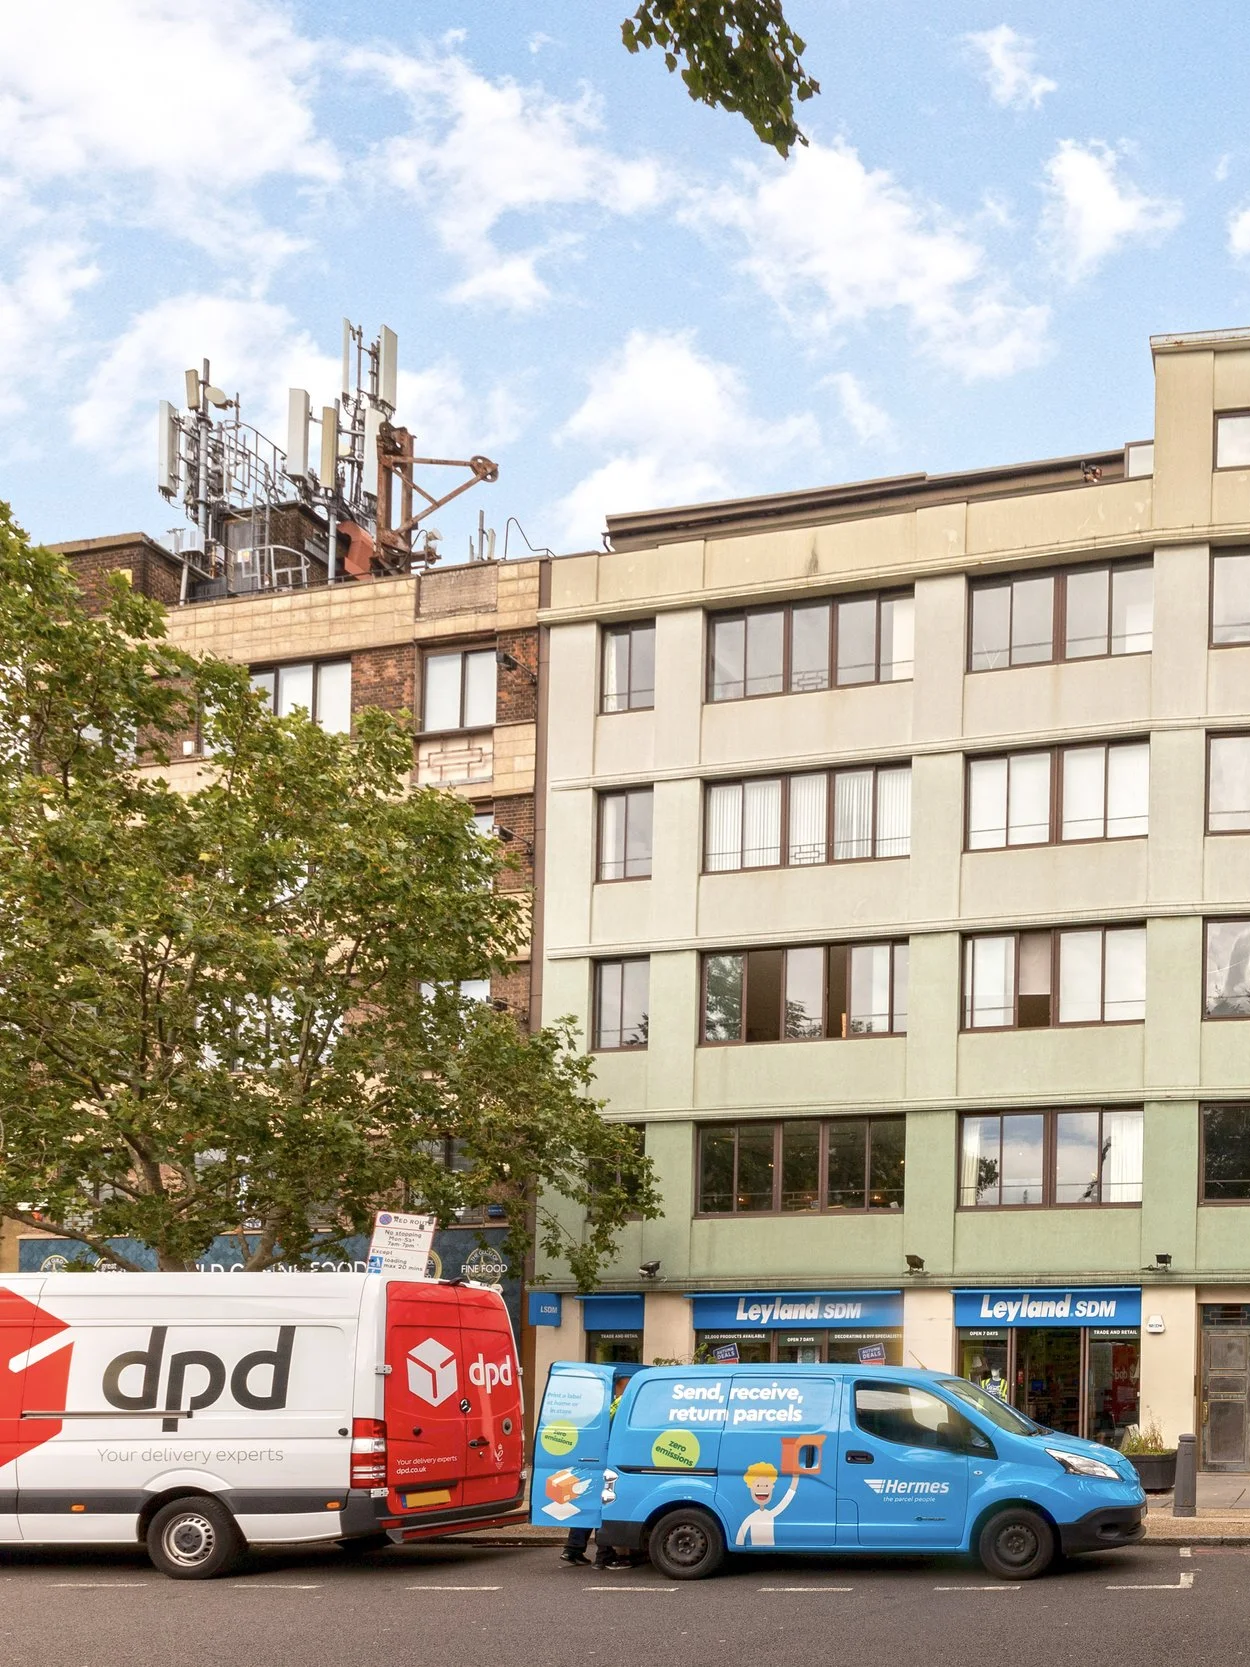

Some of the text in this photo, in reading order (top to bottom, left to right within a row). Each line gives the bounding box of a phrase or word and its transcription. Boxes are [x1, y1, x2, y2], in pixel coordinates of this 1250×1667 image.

[395, 1230, 422, 1238] stopping
[384, 1257, 407, 1265] loading
[461, 1264, 508, 1274] FINE FOOD
[540, 1305, 558, 1313] LSDM
[736, 1297, 862, 1324] Leyland SDM
[980, 1294, 1117, 1322] Leyland SDM
[717, 1350, 735, 1360] DEALS
[862, 1350, 881, 1359] DEALS
[102, 1325, 296, 1432] dpd
[468, 1353, 513, 1394] dpd
[671, 1382, 804, 1404] Send, receive,
[668, 1404, 803, 1425] return parcels
[544, 1434, 573, 1446] emissions
[668, 1440, 687, 1452] zero
[98, 1447, 284, 1464] Your delivery experts
[412, 1457, 436, 1465] delivery
[437, 1455, 458, 1463] experts
[655, 1446, 694, 1467] emissions
[396, 1466, 427, 1475] dpd.co.uk
[885, 1479, 950, 1494] Hermes
